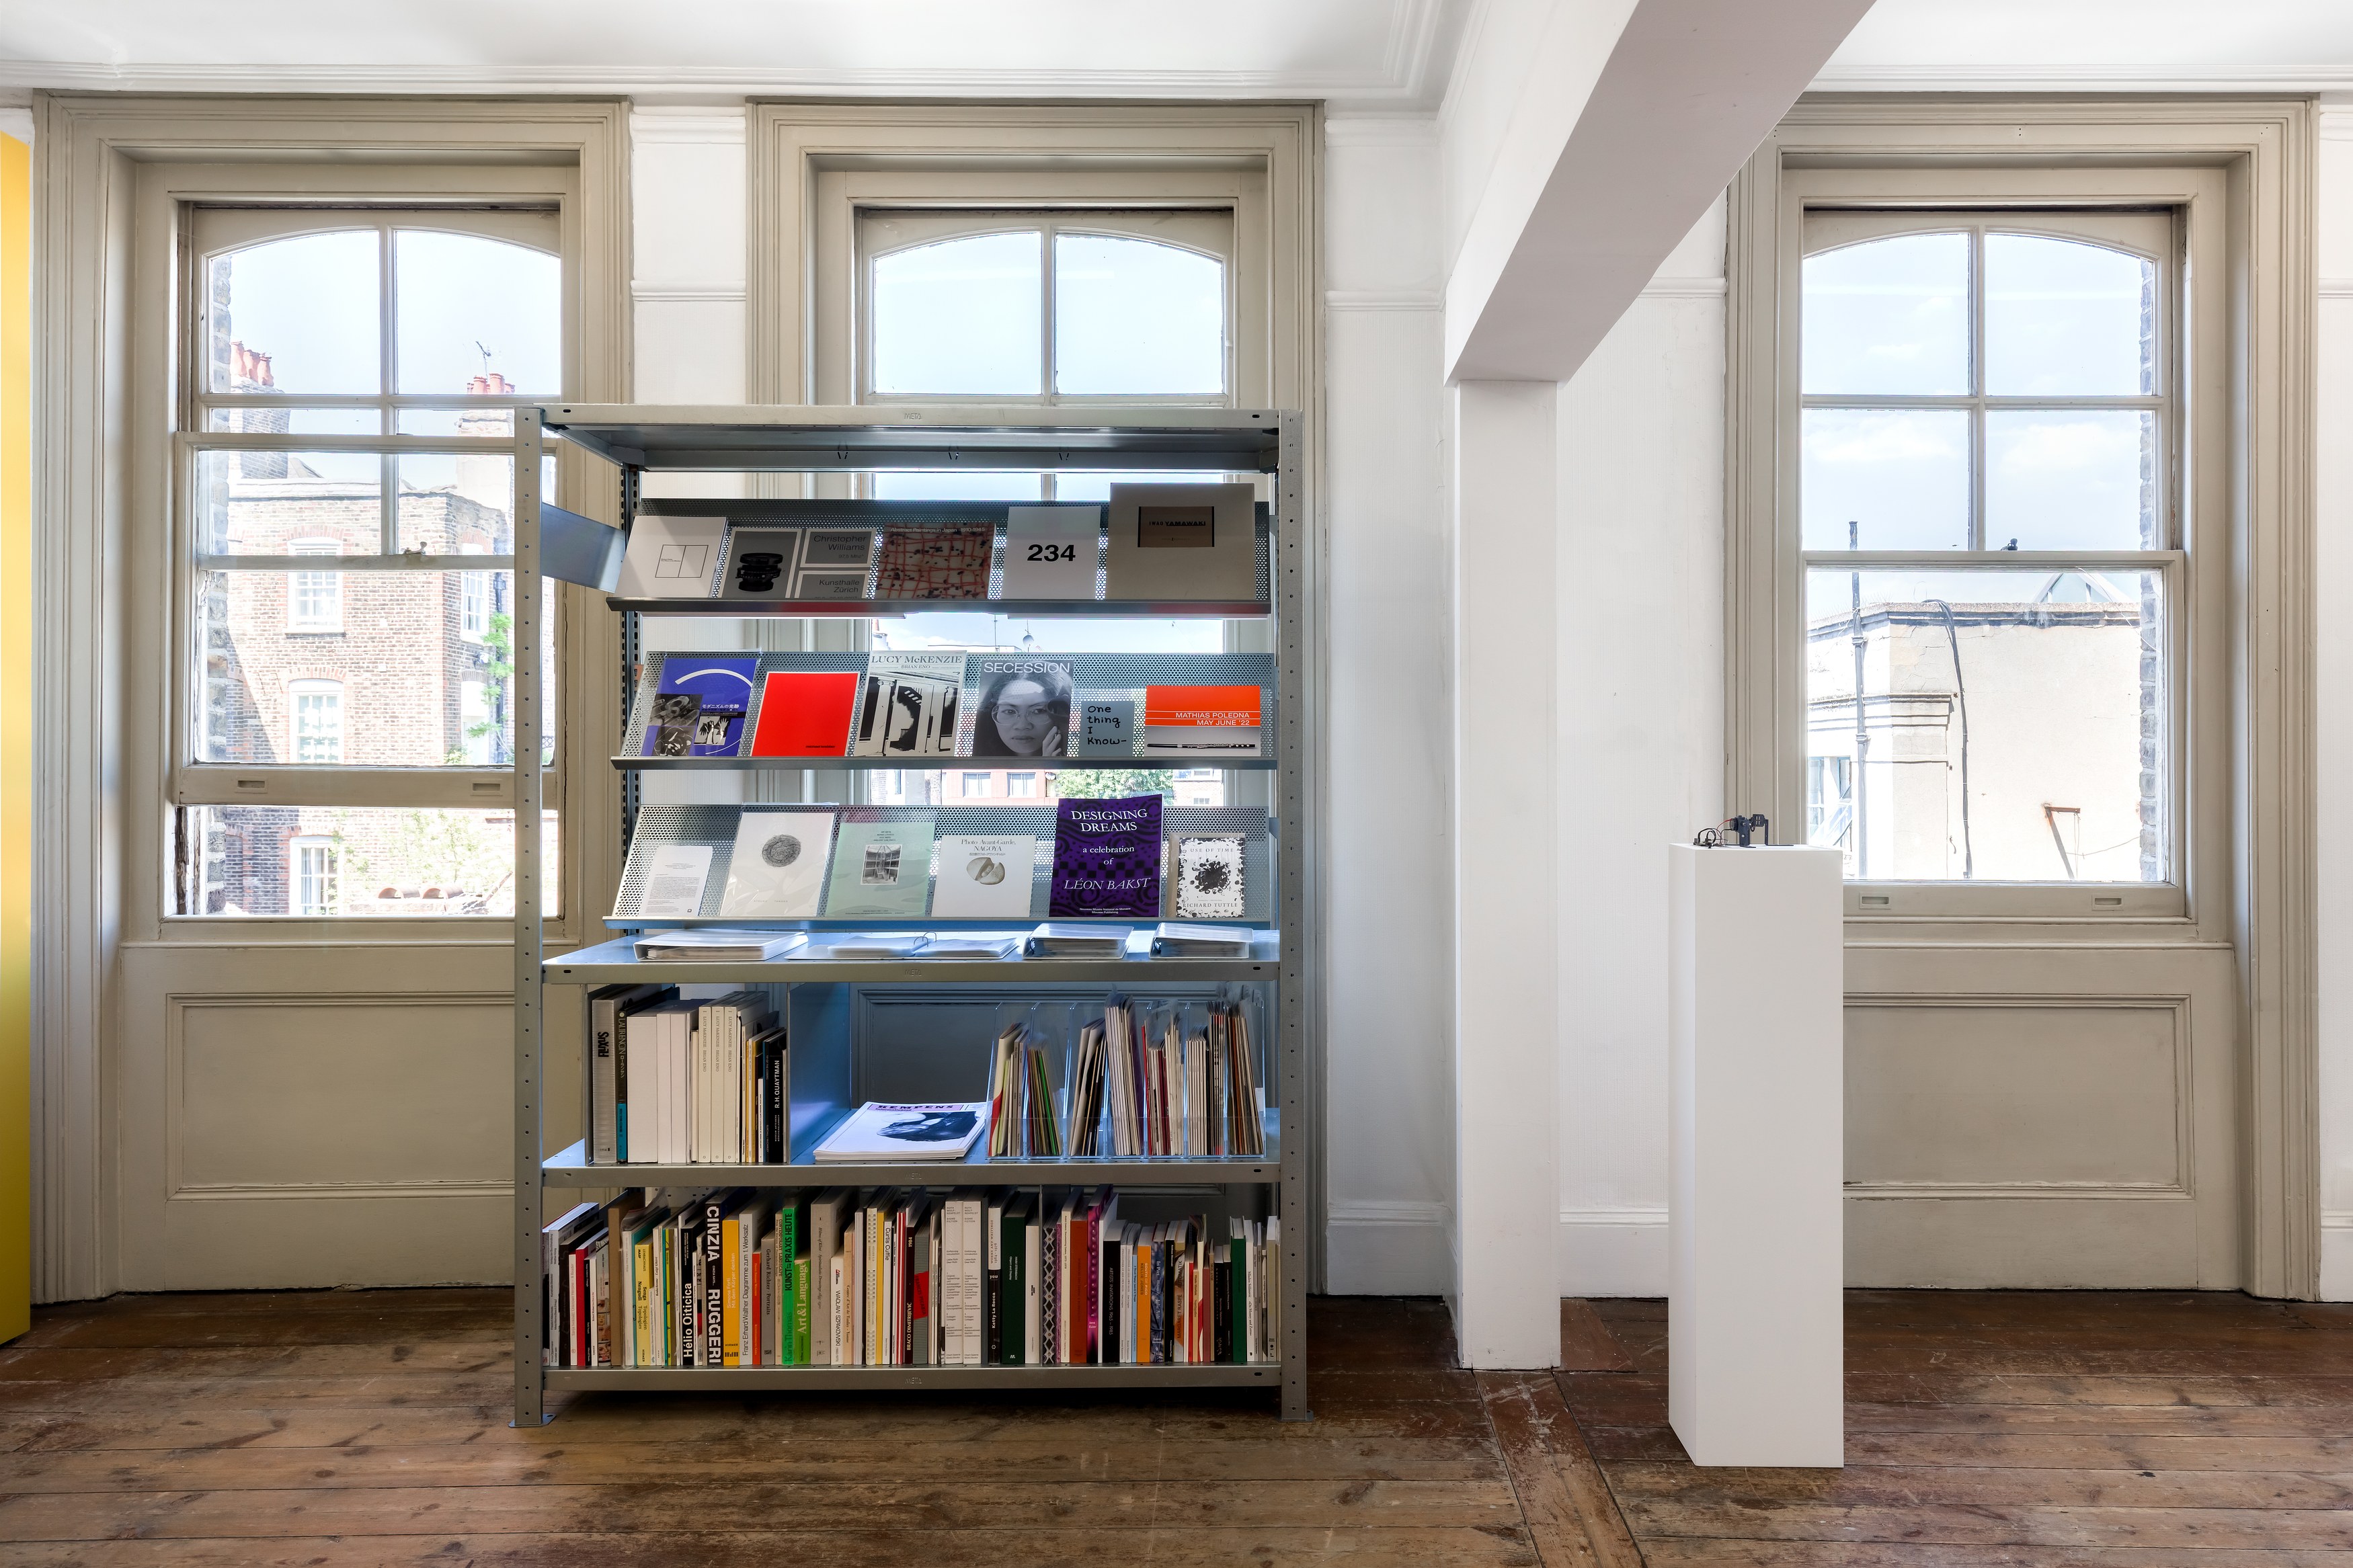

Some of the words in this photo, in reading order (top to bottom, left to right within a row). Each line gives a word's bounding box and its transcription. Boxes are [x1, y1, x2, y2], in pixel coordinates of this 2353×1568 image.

[814, 535, 866, 543] Christopher
[1027, 545, 1076, 562] 234
[984, 663, 1070, 673] SECESSION
[1087, 716, 1120, 728] thing
[1071, 809, 1148, 820] DESIGNING
[1080, 822, 1137, 832] DREAMS
[1064, 878, 1104, 890] LÉON
[1106, 877, 1151, 890] BAKST
[598, 1032, 609, 1057] FLUXUS
[707, 1206, 720, 1262] CINZIA
[797, 1264, 808, 1307] Language
[683, 1283, 692, 1325] Oiticica
[797, 1308, 807, 1316] &
[708, 1289, 721, 1363] RUGGERI
[797, 1318, 807, 1334] Art
[683, 1329, 692, 1357] Hélio
